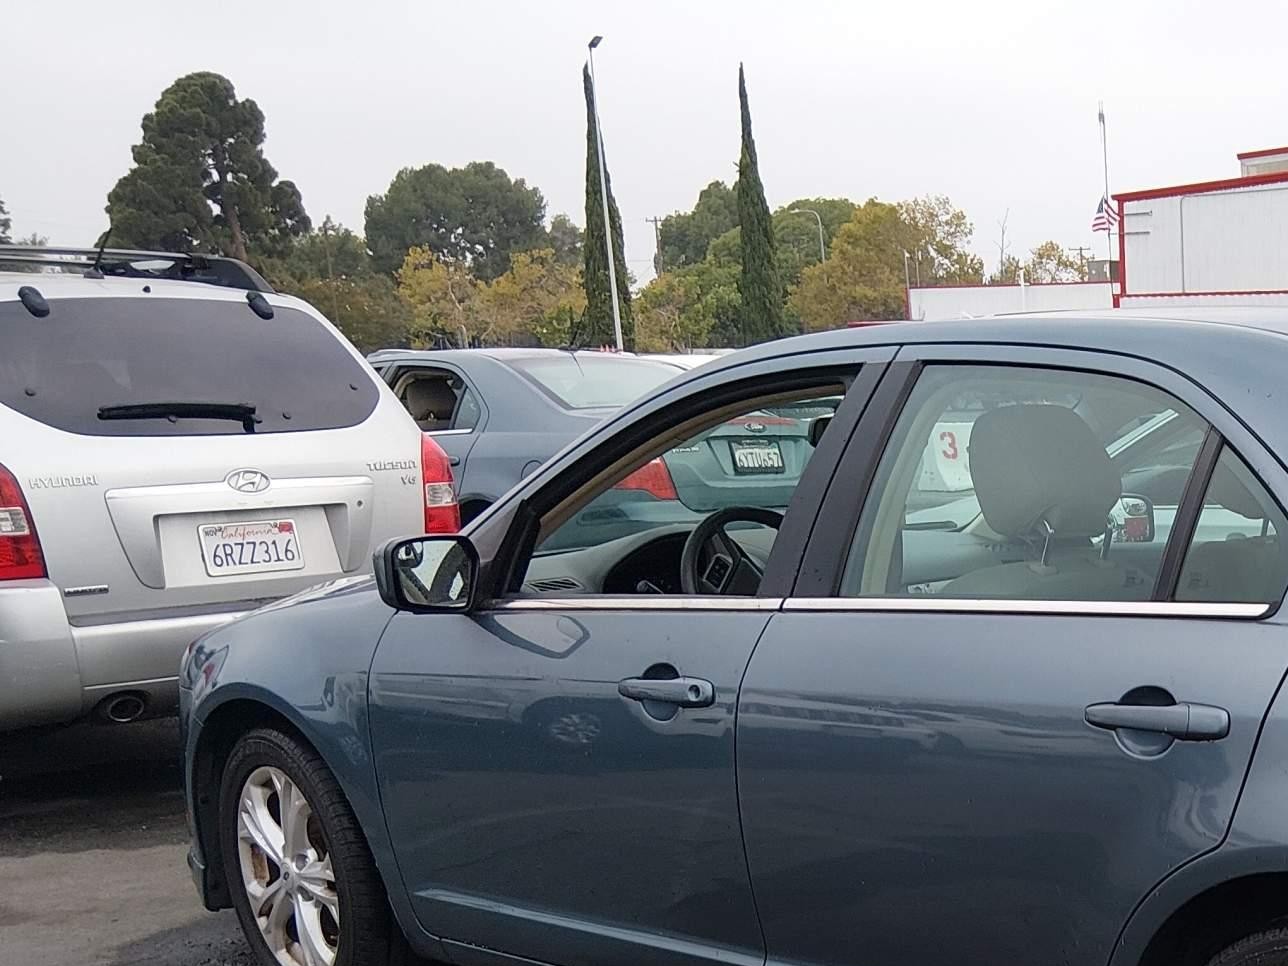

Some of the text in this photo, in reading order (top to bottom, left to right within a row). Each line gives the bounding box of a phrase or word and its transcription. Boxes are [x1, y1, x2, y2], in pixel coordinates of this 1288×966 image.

[940, 431, 958, 460] 3
[366, 460, 417, 472] TUCSON
[29, 474, 99, 489] HYUNDAI
[400, 474, 416, 486] V6
[221, 526, 276, 541] California
[213, 538, 295, 568] 6RZZ316
